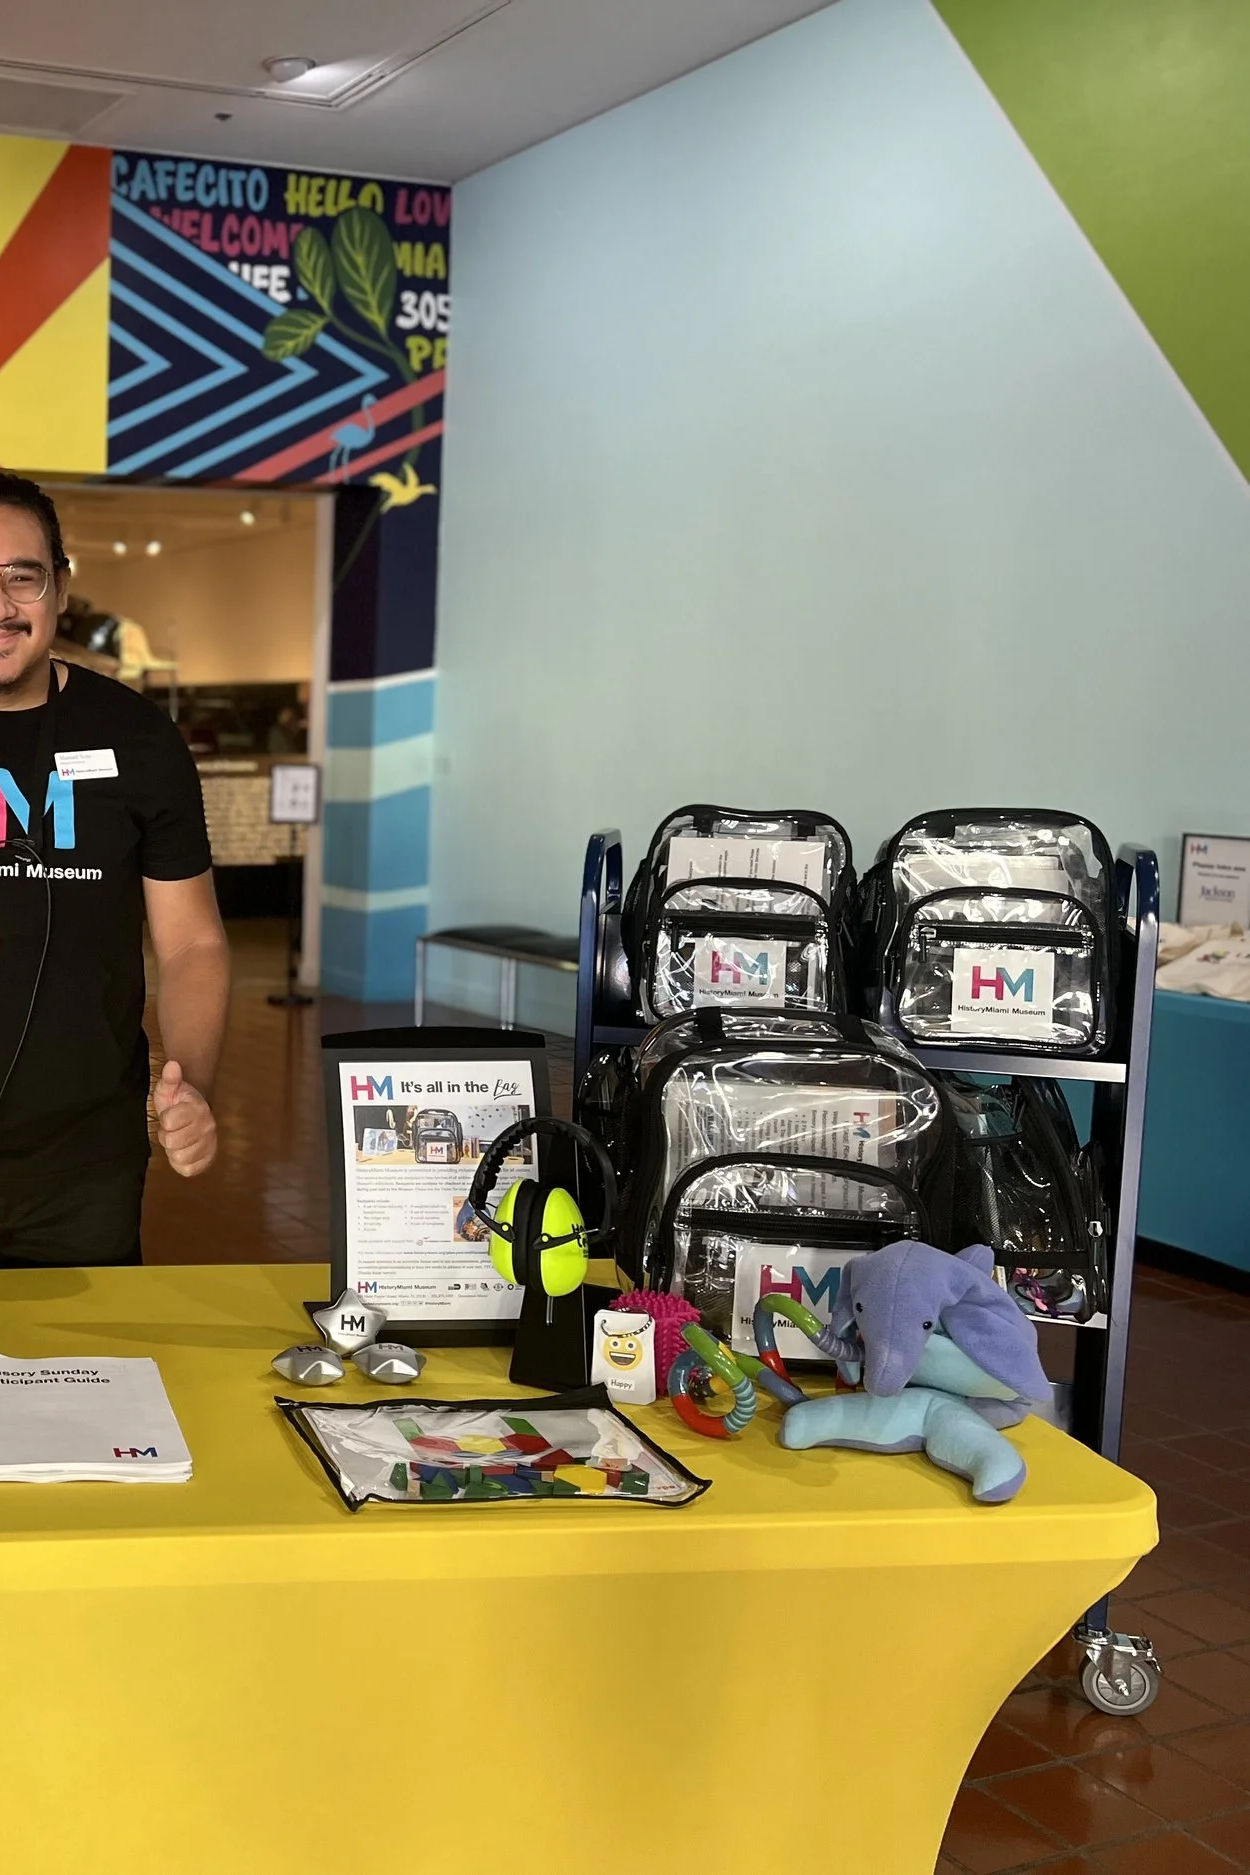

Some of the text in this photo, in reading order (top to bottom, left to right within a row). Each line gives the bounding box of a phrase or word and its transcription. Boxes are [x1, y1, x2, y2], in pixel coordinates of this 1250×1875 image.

[113, 156, 269, 212] CAFECITO
[228, 261, 292, 304] IFE
[395, 291, 450, 332] 305
[26, 863, 103, 880] Museum
[711, 951, 769, 985] HM
[971, 965, 1034, 1002] HM
[957, 1004, 1046, 1016] HistoryMiami Museum
[350, 1075, 522, 1101] HM It's all in the Bag
[357, 1281, 378, 1293] HM
[378, 1283, 412, 1291] HistoryMiami
[760, 1264, 841, 1313] HM
[341, 1314, 365, 1332] HM
[40, 1368, 99, 1376] Sunday
[63, 1376, 110, 1384] Guide
[611, 1380, 633, 1390] Happy
[113, 1447, 158, 1457] HM
